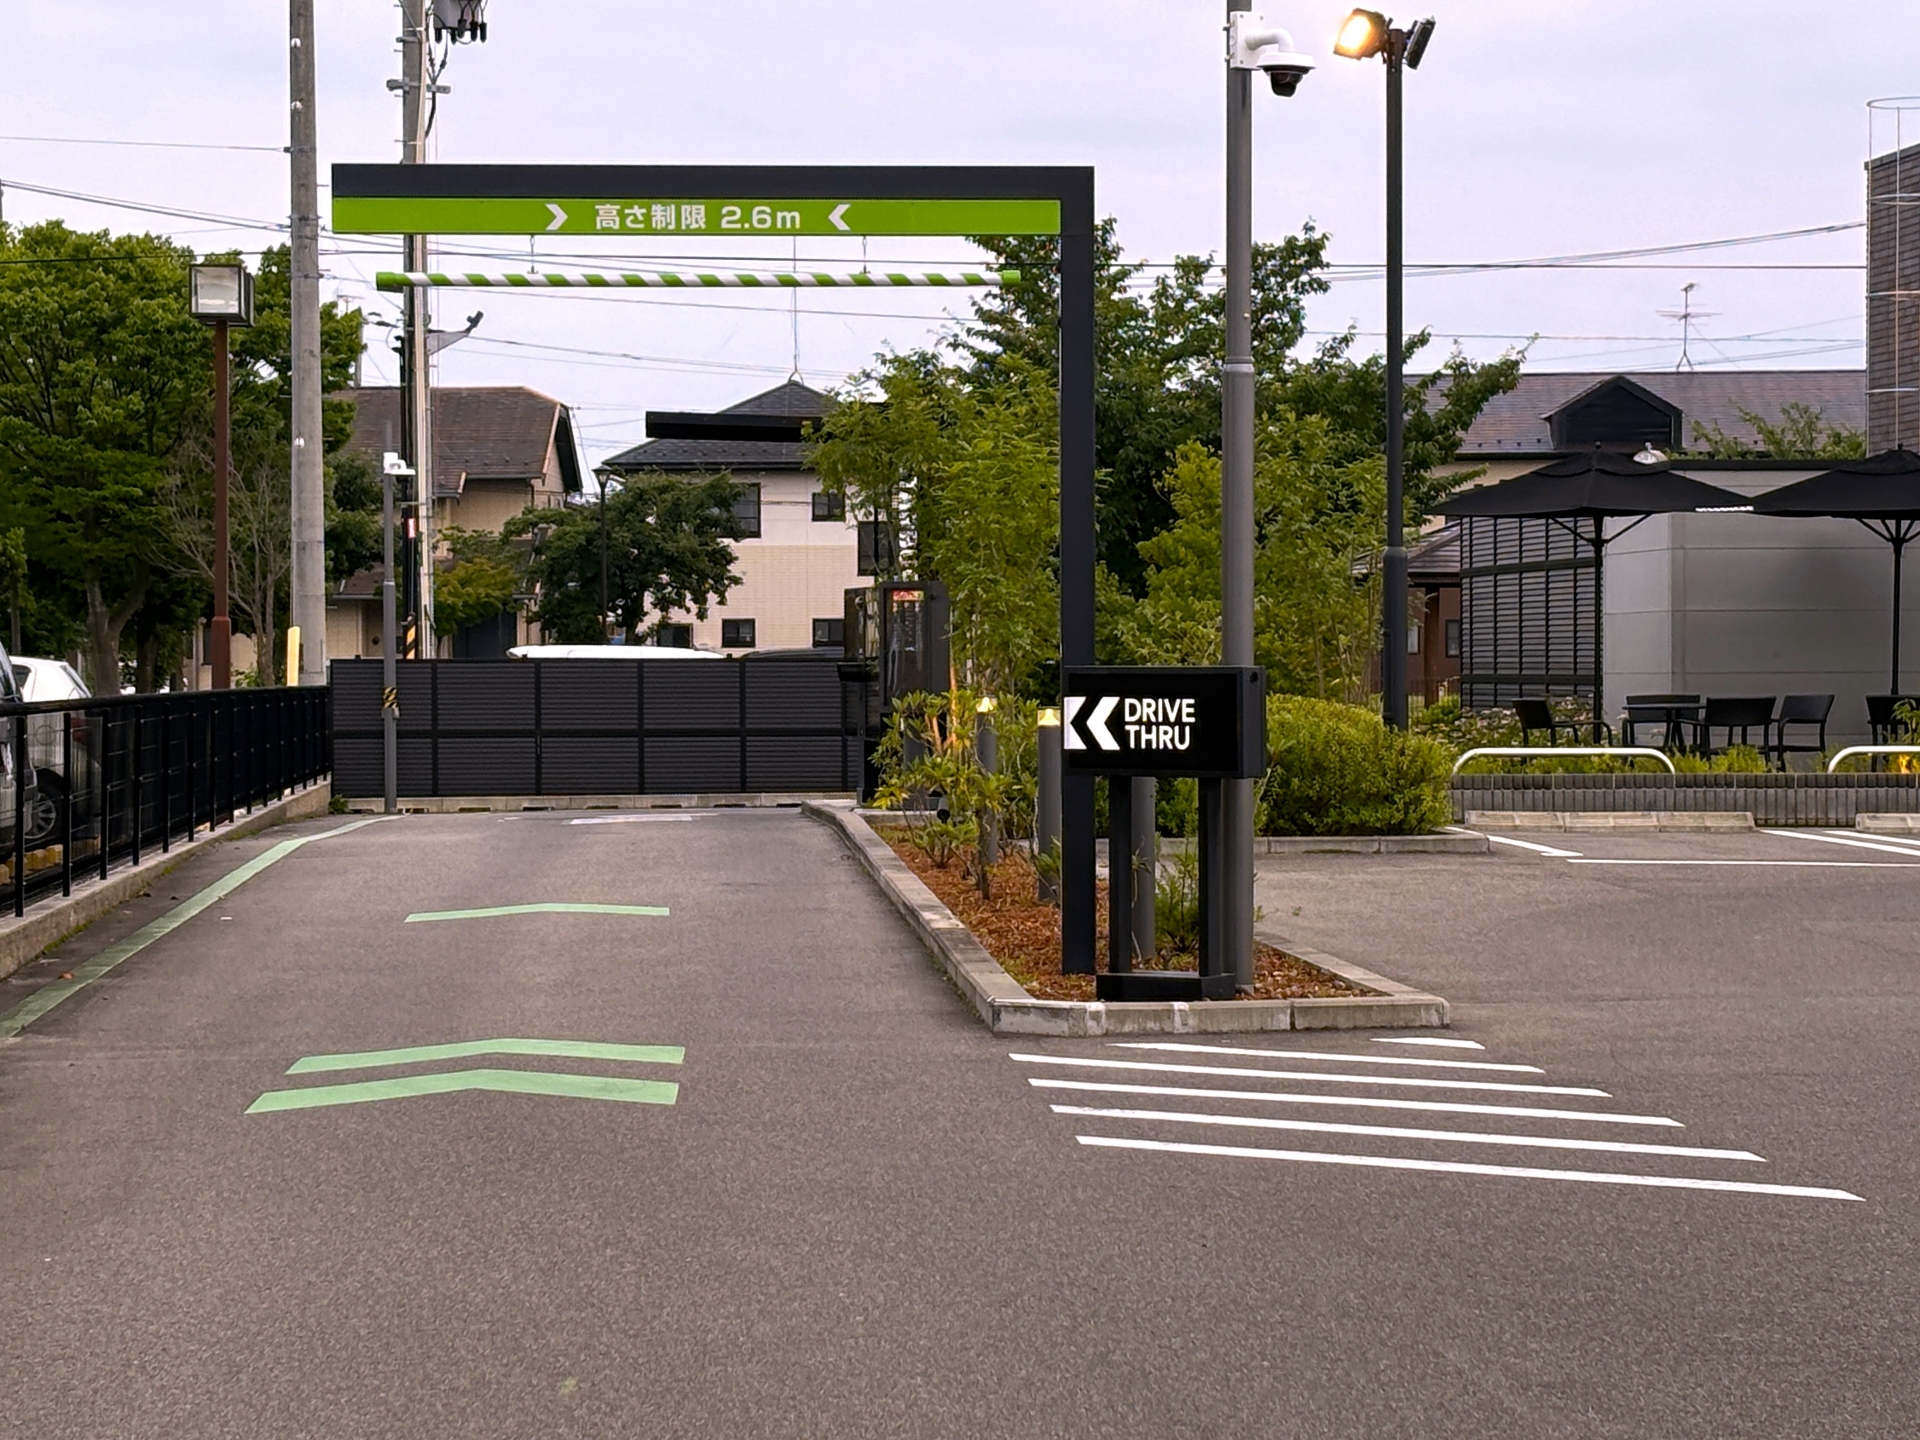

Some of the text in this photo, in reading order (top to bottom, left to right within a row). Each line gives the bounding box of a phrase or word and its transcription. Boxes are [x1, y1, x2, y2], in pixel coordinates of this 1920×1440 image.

[594, 204, 801, 230] 高さ制限 2.6m
[1124, 698, 1196, 723] DRIVE
[1124, 725, 1190, 750] THRU
